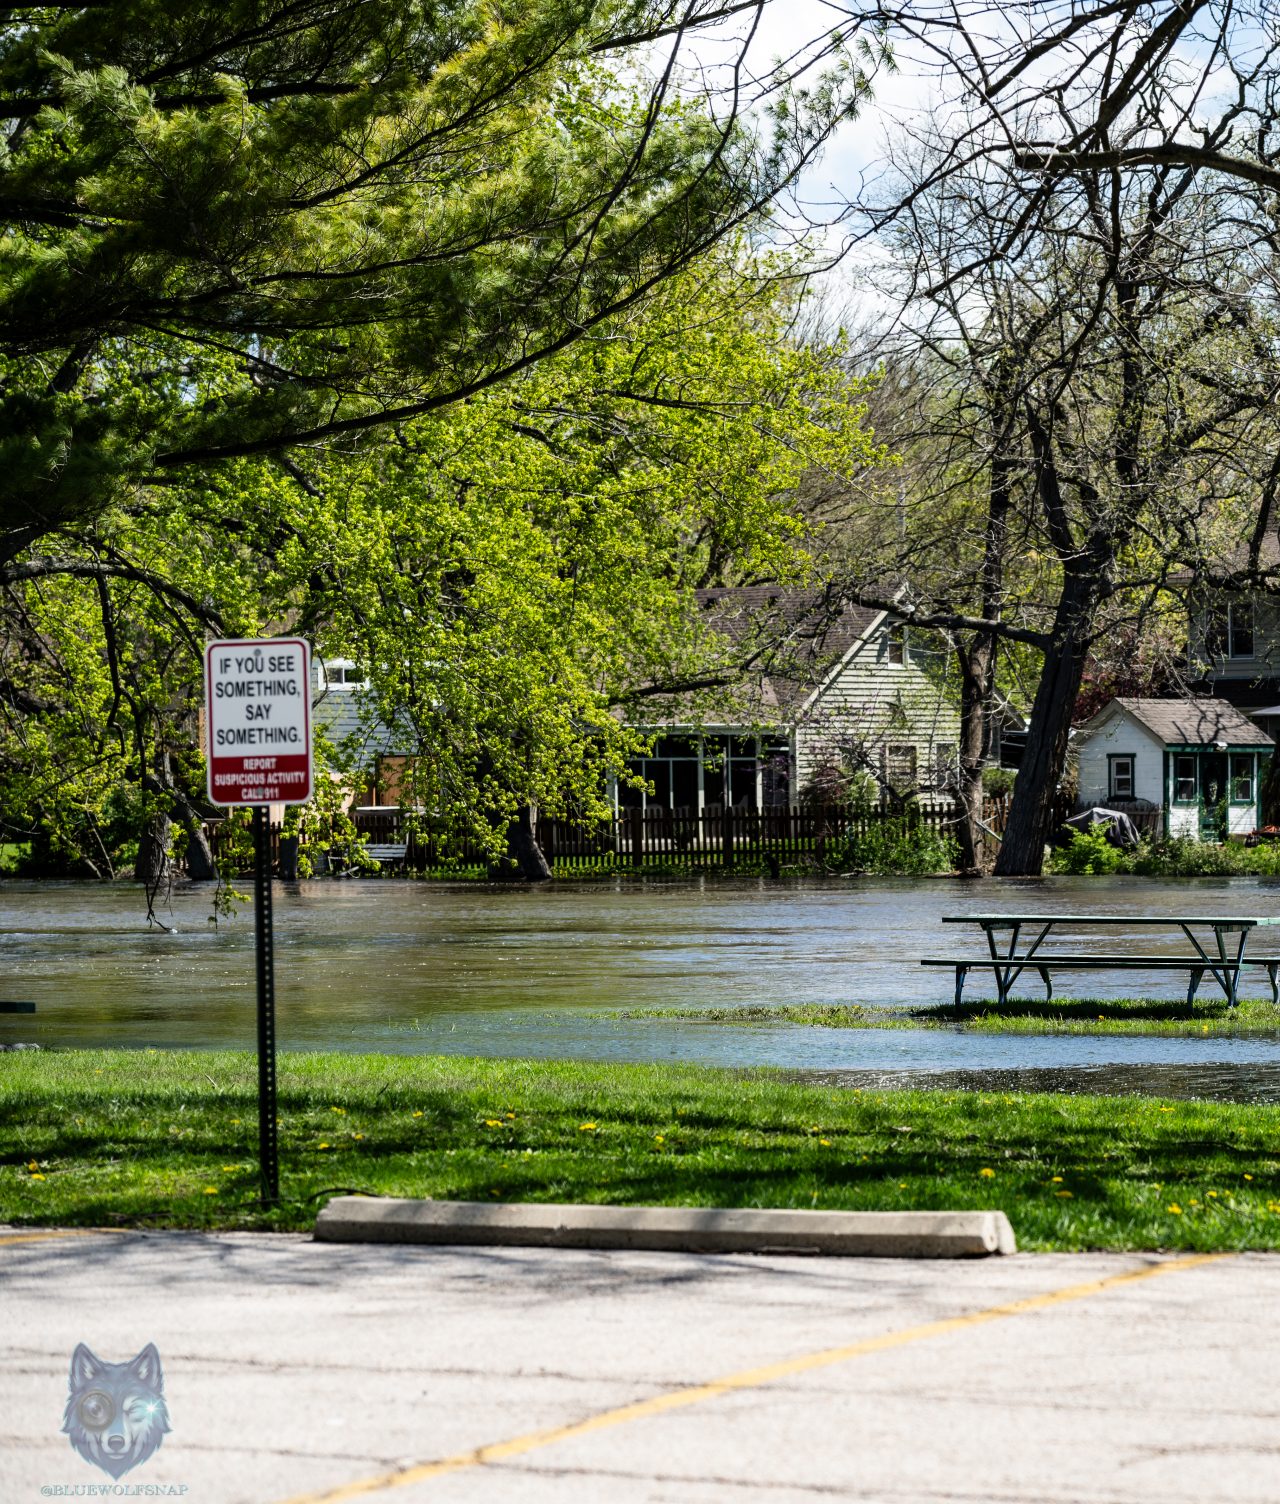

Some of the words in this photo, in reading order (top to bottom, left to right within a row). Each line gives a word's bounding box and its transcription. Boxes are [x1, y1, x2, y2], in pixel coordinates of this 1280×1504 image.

[220, 658, 231, 674] IF
[235, 657, 264, 673] YOU
[268, 656, 294, 672] SEE
[215, 680, 300, 698] SOMETHING,
[245, 704, 272, 721] SAY
[216, 726, 302, 745] SOMETHING.
[243, 758, 277, 770] REPORT
[214, 773, 265, 786] SUSPICIOUS
[267, 771, 305, 784] ACTIVITY
[264, 787, 279, 798] 911
